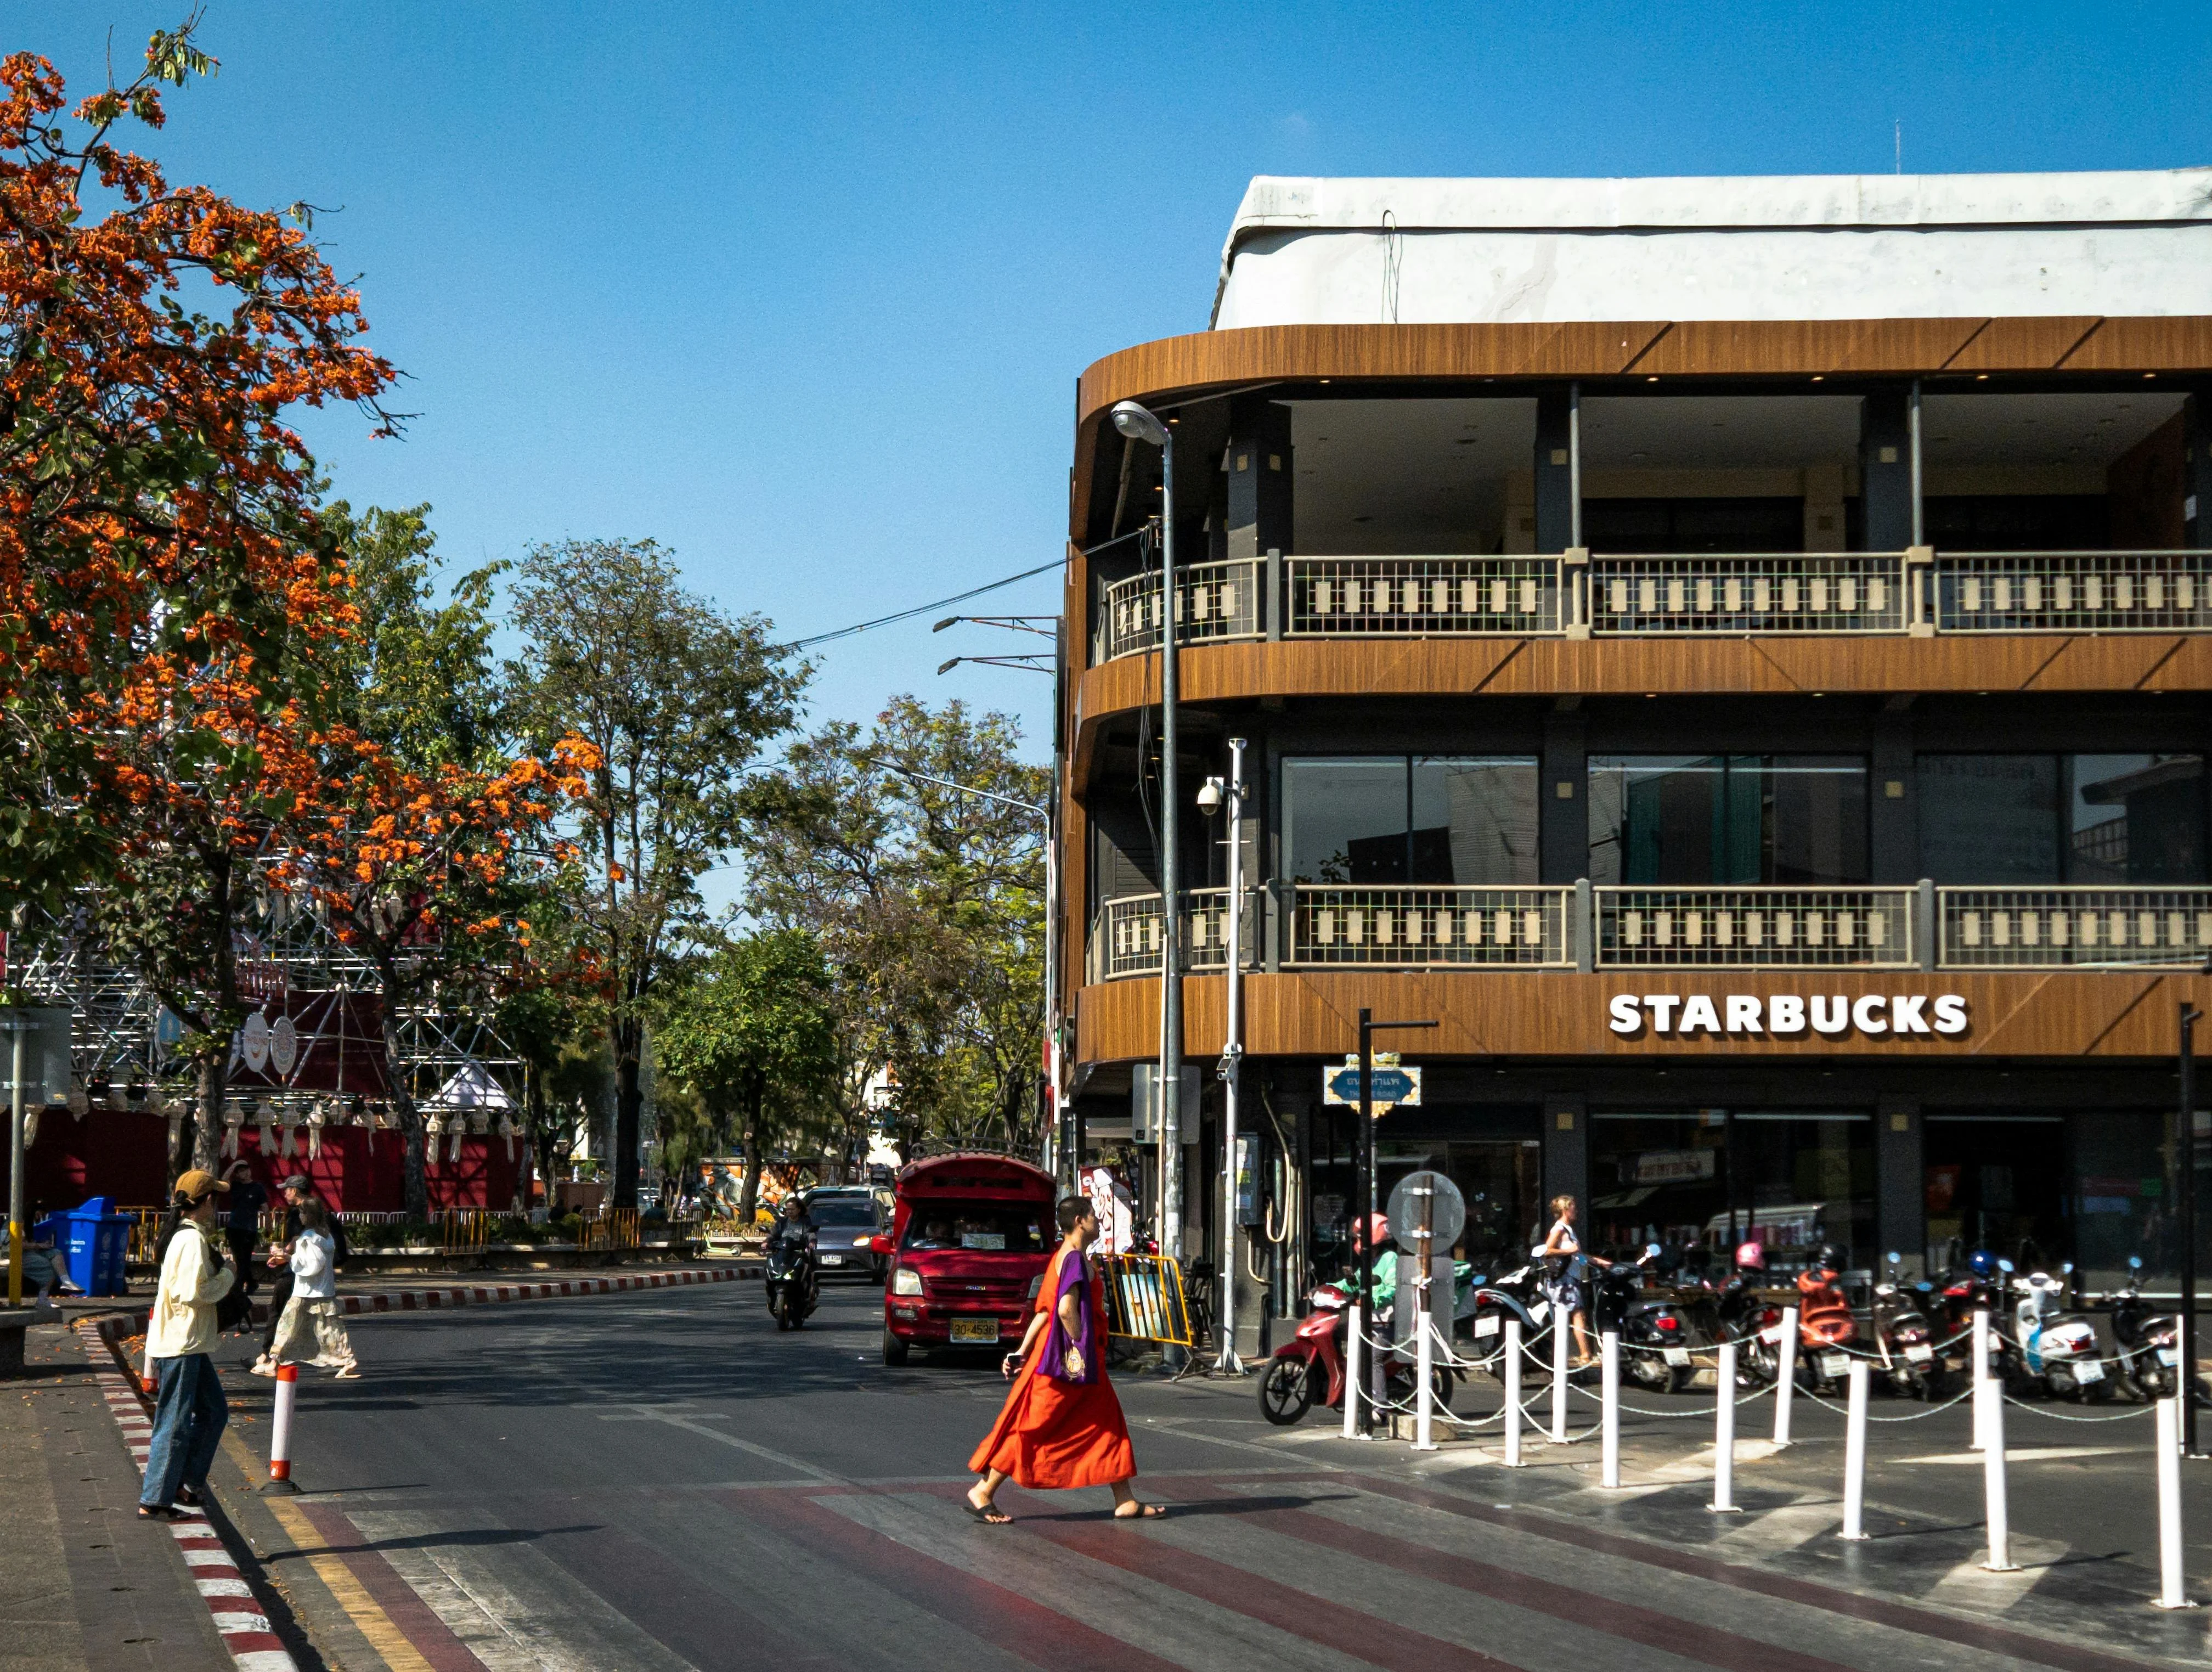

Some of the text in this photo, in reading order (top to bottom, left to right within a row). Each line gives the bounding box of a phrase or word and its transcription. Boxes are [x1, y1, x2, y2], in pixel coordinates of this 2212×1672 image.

[1609, 994, 1967, 1033] STARBUCKS
[1347, 1074, 1400, 1085] ถนท่าแพ
[955, 1324, 995, 1335] 30-4536
